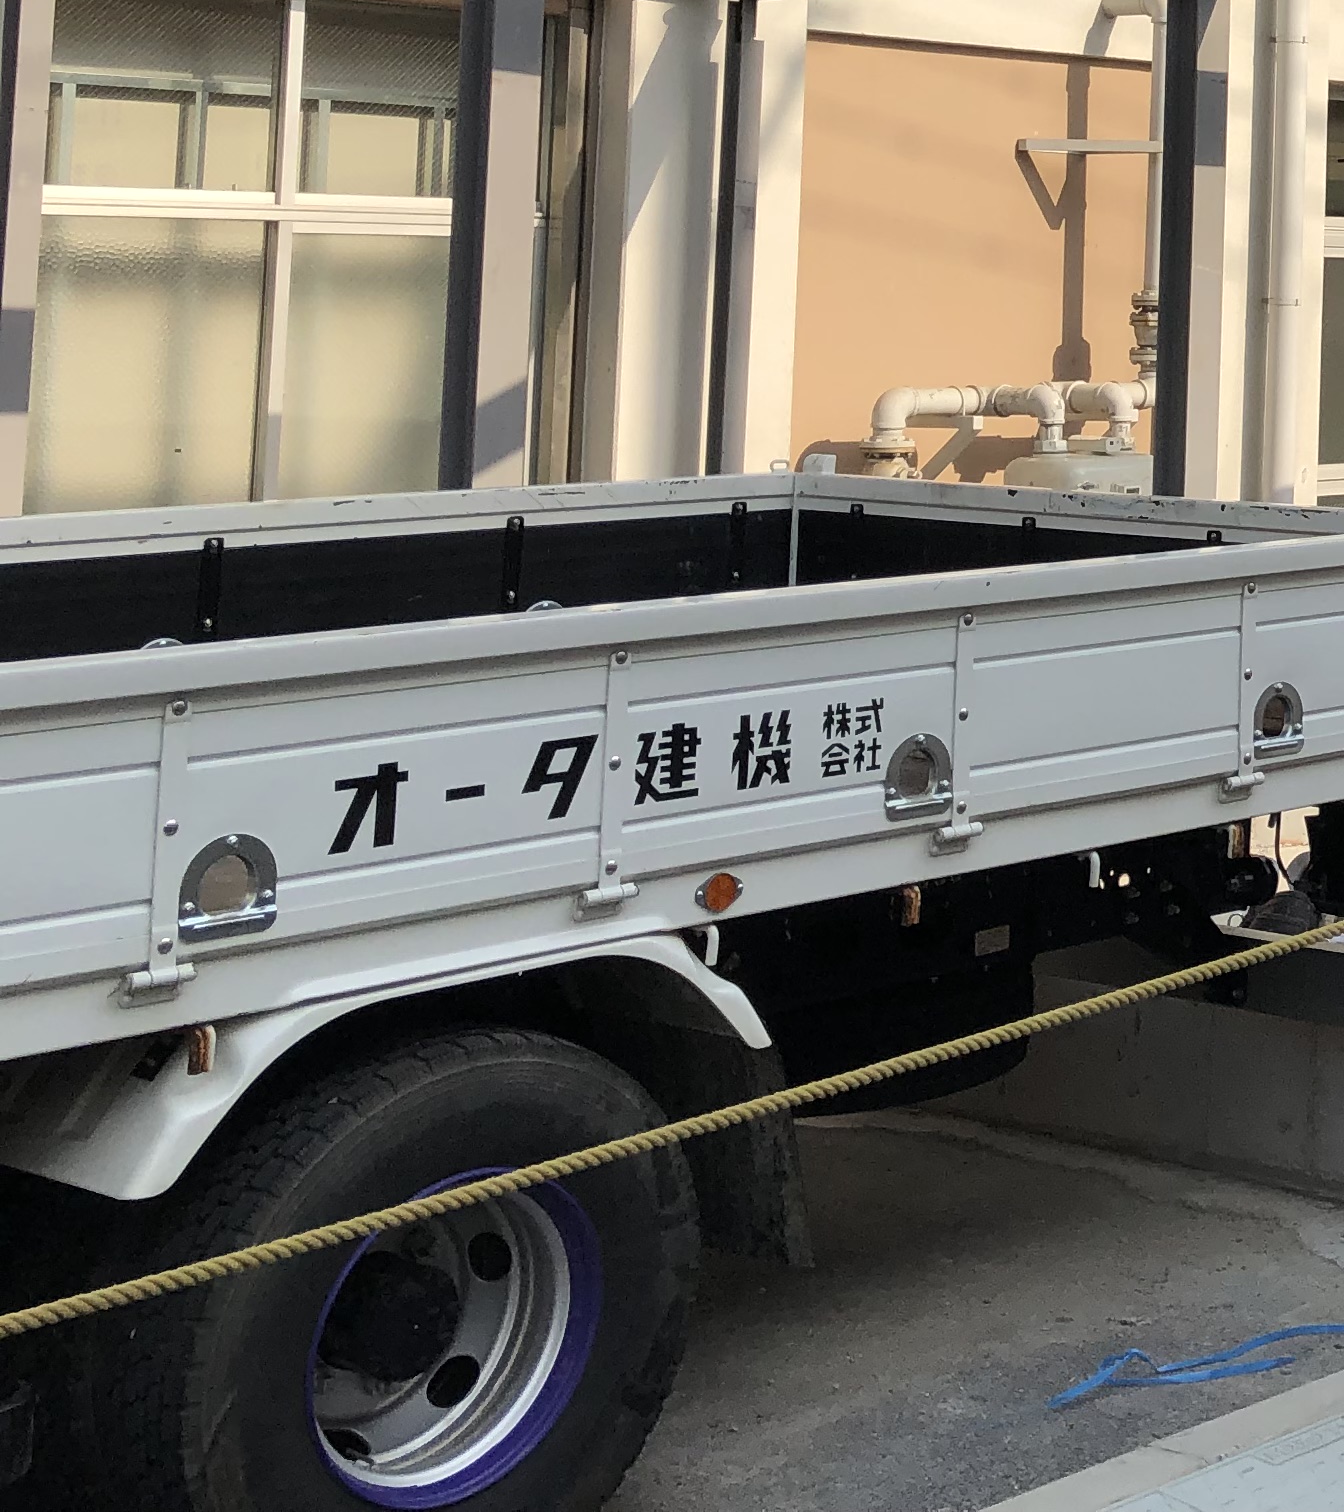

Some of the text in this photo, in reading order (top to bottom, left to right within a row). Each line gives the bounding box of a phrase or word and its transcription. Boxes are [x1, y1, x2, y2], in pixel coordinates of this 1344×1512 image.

[821, 697, 885, 739] 株式
[820, 738, 883, 779] 会社
[326, 708, 792, 855] オータ建機
